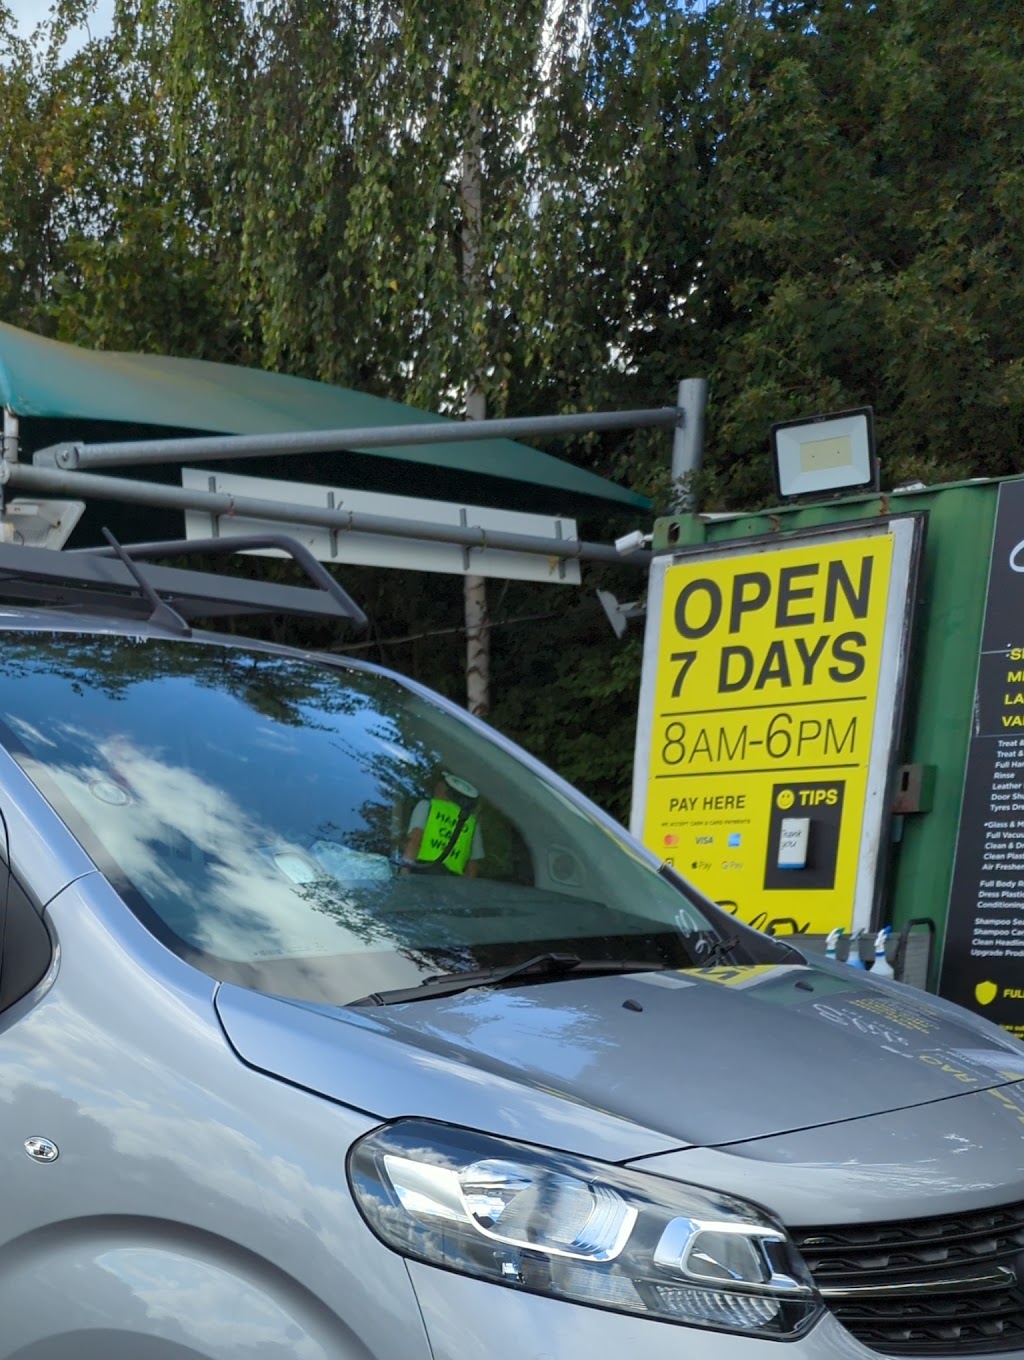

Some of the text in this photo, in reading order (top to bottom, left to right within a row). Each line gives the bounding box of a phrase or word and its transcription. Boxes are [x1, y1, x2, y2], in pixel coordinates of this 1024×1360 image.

[674, 555, 874, 639] OPEN
[670, 631, 867, 698] 7 DAYS
[662, 713, 857, 766] 8AM-6PM
[998, 740, 1017, 748] Treat
[997, 749, 1024, 758] Treat &
[798, 788, 838, 806] TIPS
[991, 793, 1010, 801] Door
[669, 794, 746, 812] PAY HERE
[990, 804, 1010, 812] Tyres
[986, 831, 1001, 839] Full
[695, 835, 714, 845] VISA
[699, 861, 713, 872] Pay
[995, 880, 1017, 888] Body
[978, 890, 999, 898] Dress
[974, 917, 1011, 926] Shampoo
[973, 927, 1010, 936] Shampoo
[971, 938, 994, 946] Clean
[970, 948, 1004, 957] Upgrade
